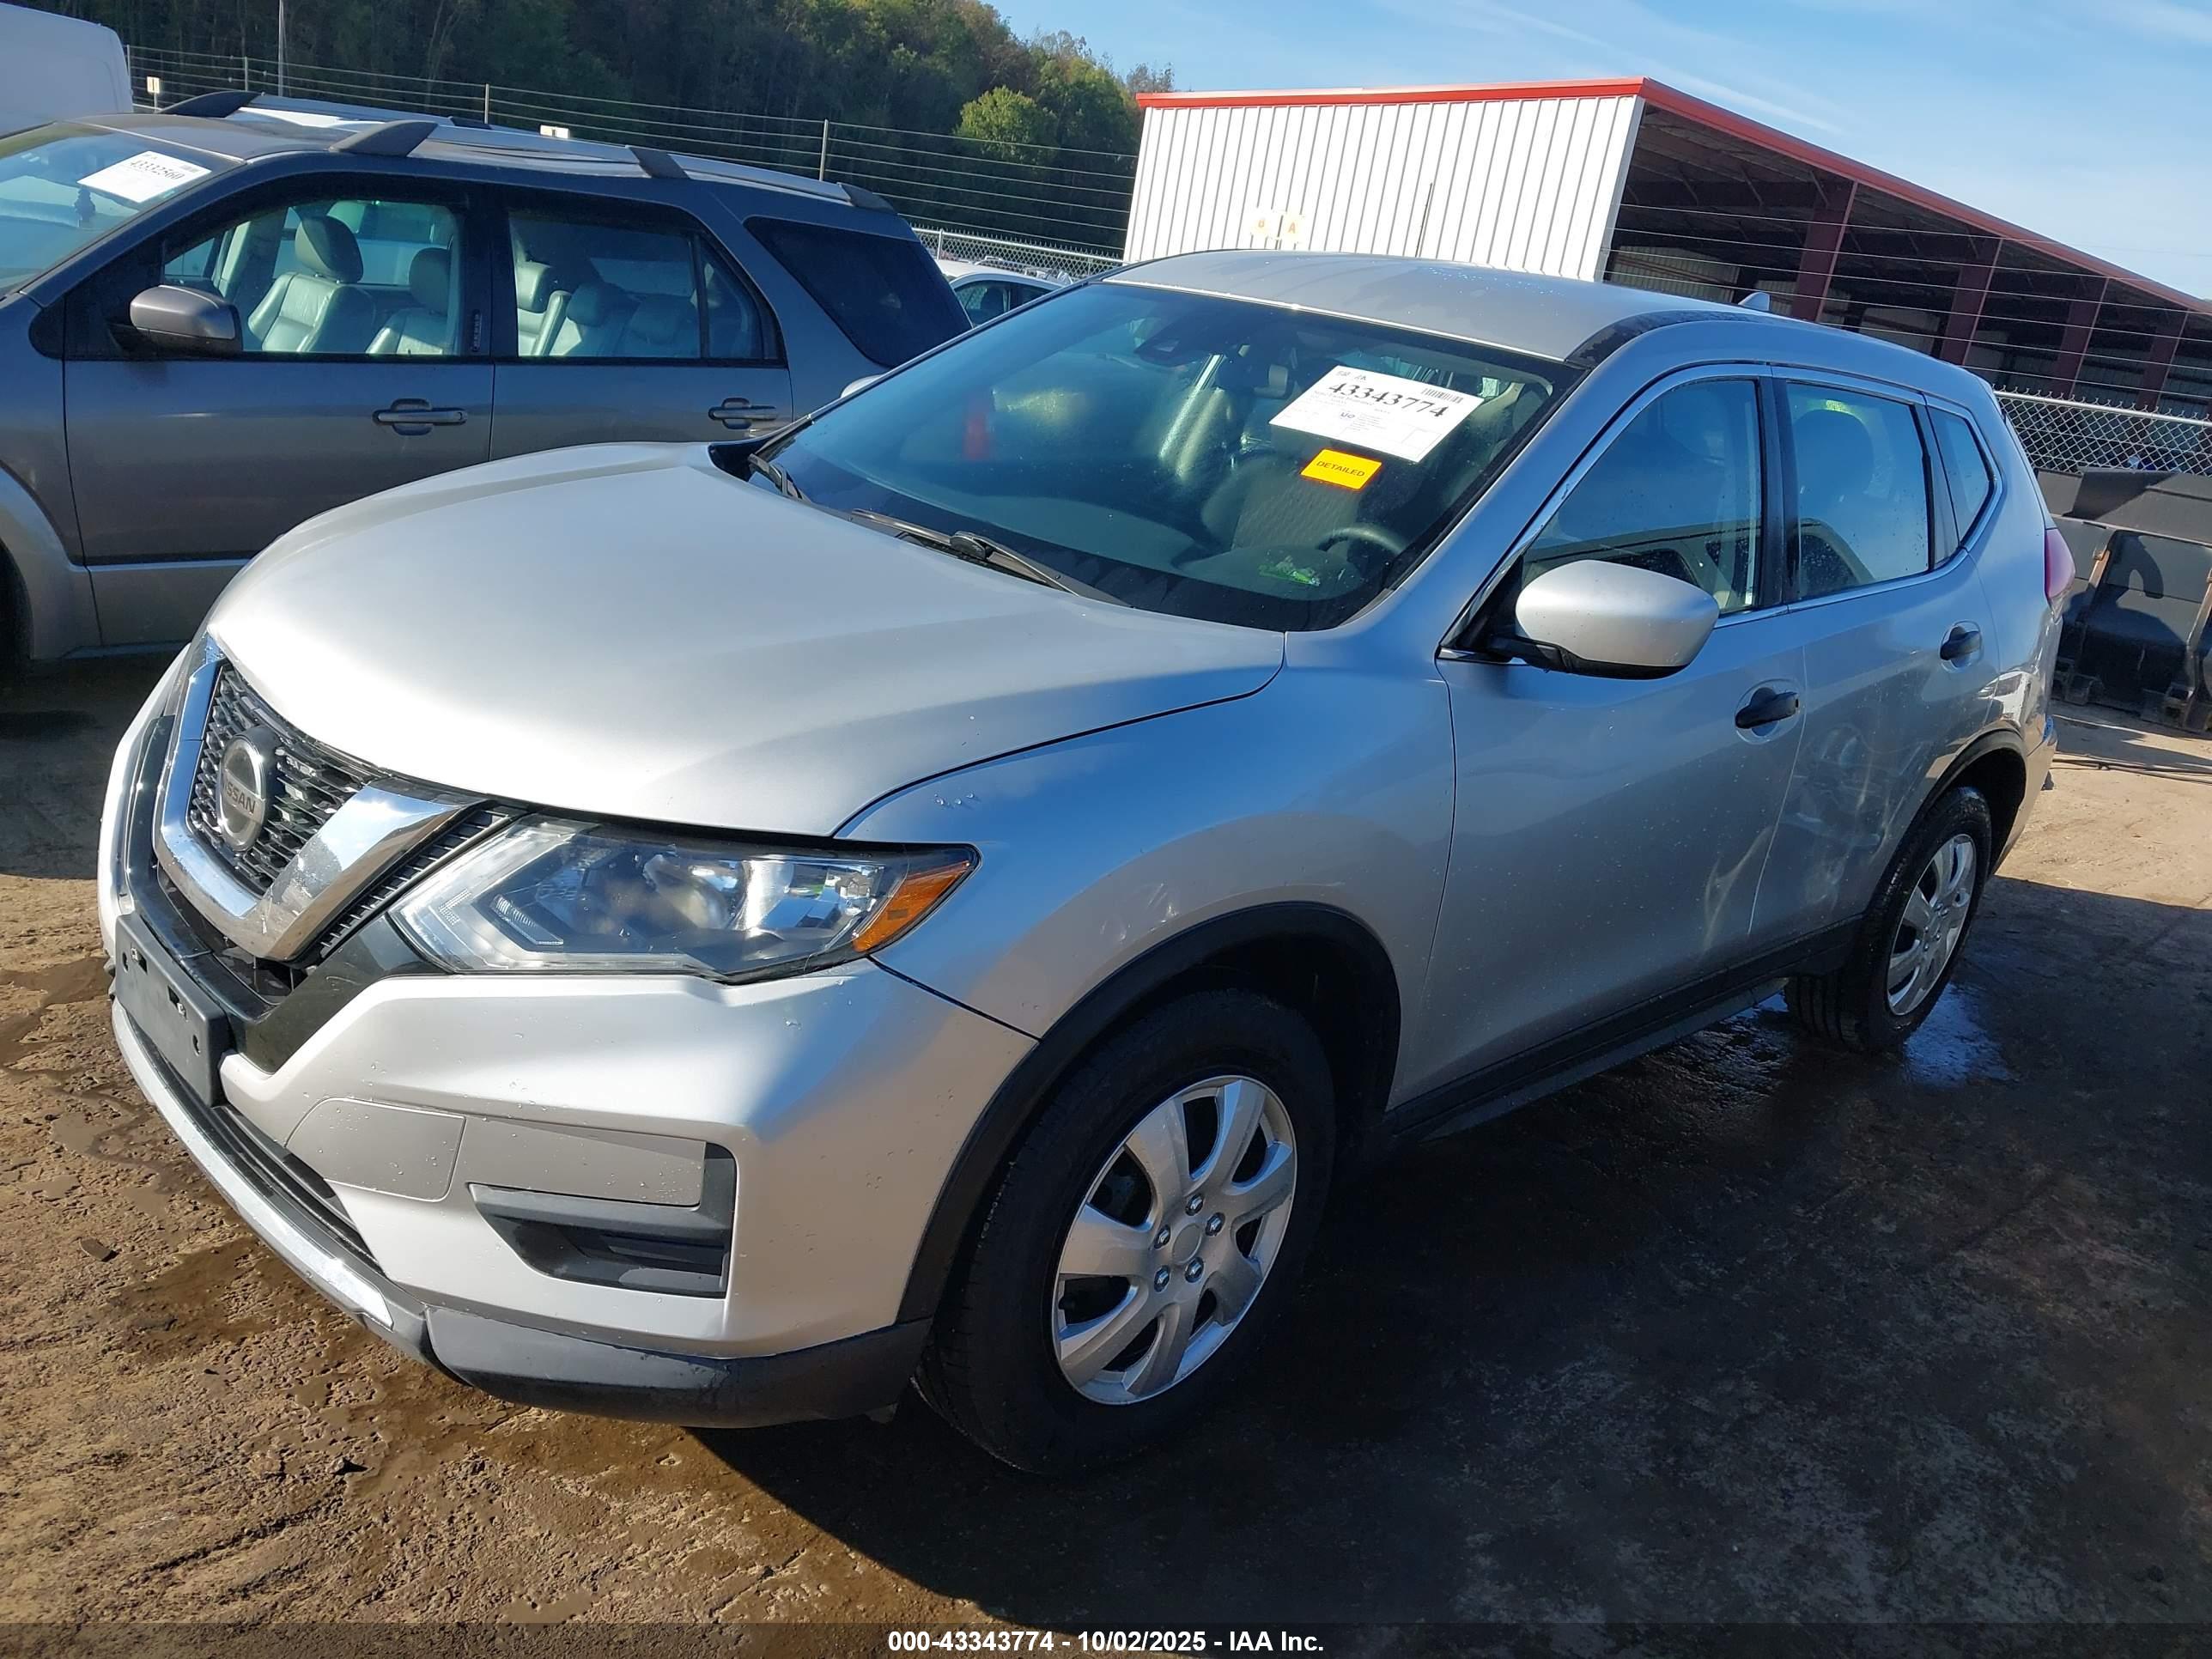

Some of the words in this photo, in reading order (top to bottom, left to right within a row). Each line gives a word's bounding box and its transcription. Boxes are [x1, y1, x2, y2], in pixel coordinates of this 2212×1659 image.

[1287, 221, 1297, 234] A
[1328, 382, 1449, 417] 43343774
[1316, 460, 1365, 477] DETAILED
[222, 773, 256, 814] ISSAN
